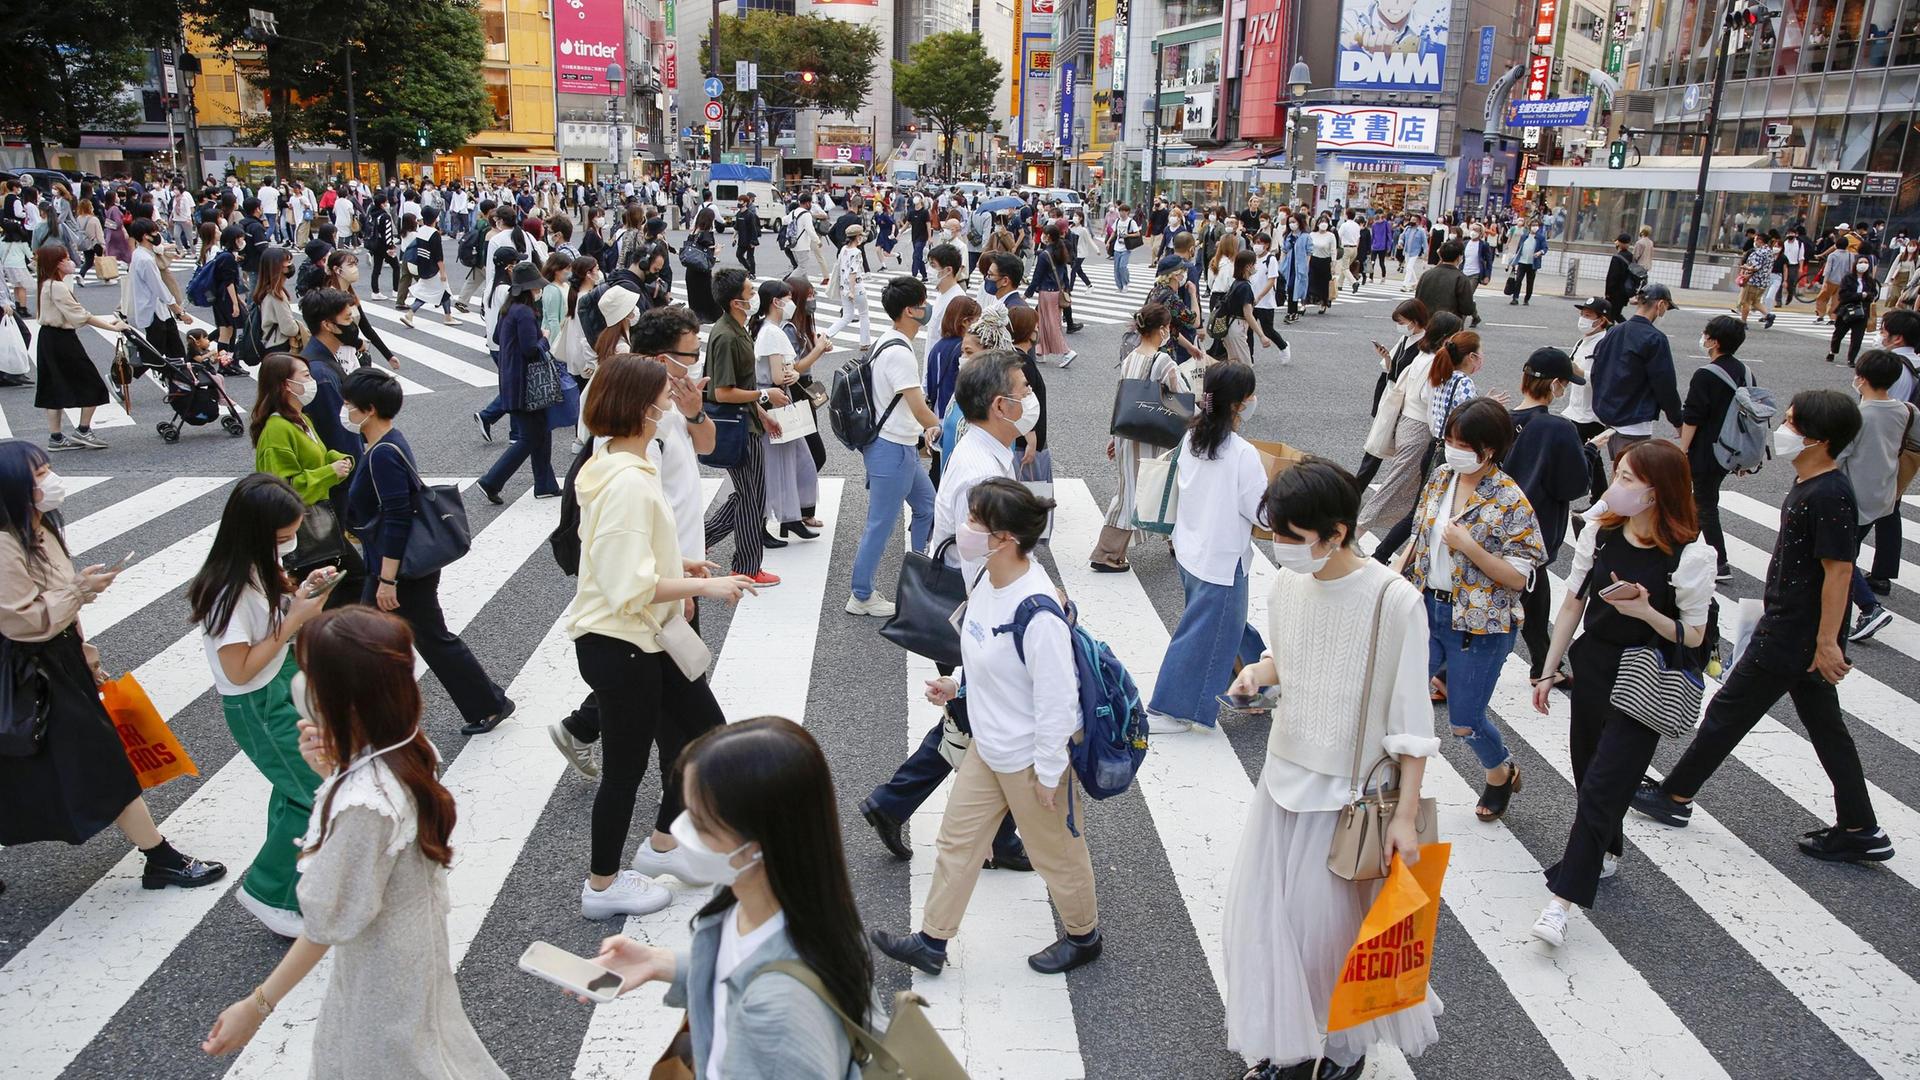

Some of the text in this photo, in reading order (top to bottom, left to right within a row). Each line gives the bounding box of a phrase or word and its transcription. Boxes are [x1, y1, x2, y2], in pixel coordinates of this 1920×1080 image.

[574, 40, 617, 59] tinder
[1339, 51, 1440, 84] DMM
[1317, 114, 1426, 143] 堂書店
[1351, 162, 1392, 172] YOASOBI
